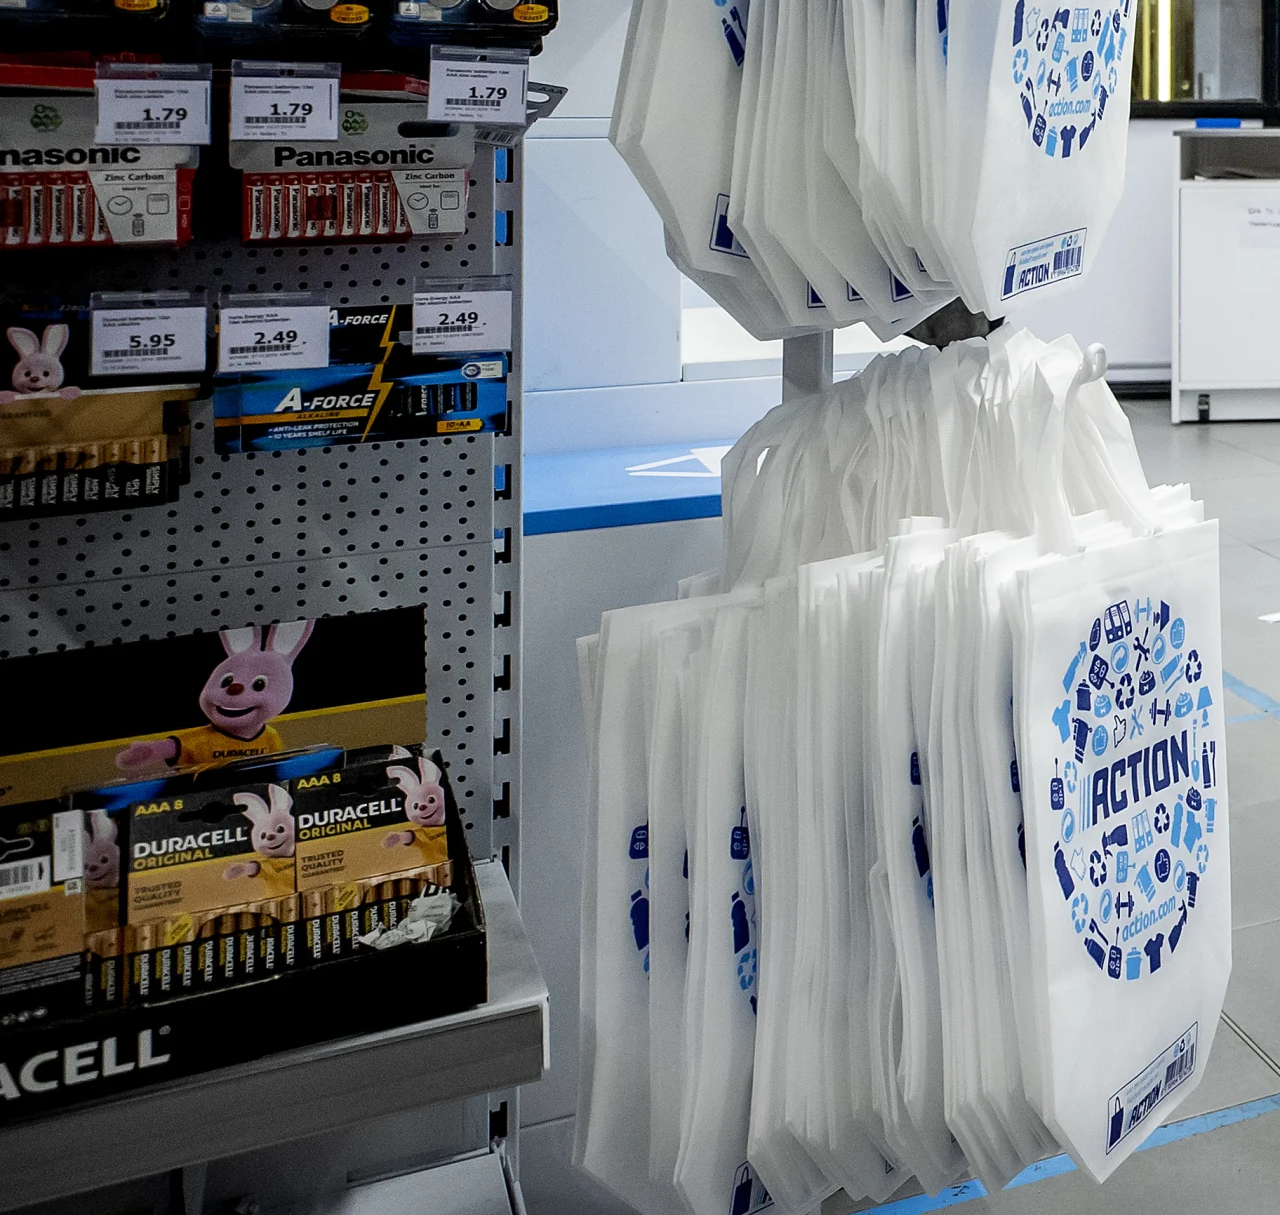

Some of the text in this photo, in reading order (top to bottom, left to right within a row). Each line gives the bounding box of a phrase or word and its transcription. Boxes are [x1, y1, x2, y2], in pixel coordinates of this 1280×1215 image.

[468, 87, 508, 100] 1.79
[142, 108, 188, 121] 1.79
[269, 102, 313, 117] 1.79
[1049, 98, 1092, 120] action.com
[0, 147, 141, 165] nasonic
[274, 144, 435, 167] Panasonic
[104, 172, 164, 182] Zinc Carbon
[254, 189, 263, 234] Panasonic
[1018, 262, 1050, 289] ACTION
[438, 312, 478, 325] 2.49
[129, 334, 176, 349] 5.95
[254, 330, 298, 344] 2.49
[275, 387, 375, 413] A-FORCE
[296, 411, 340, 419] ALKALINE
[284, 431, 308, 439] YEARS
[309, 429, 329, 437] SHELF
[315, 421, 359, 430] PROTECTION
[298, 773, 341, 789] AAA 8
[1092, 730, 1190, 825] ACTION
[299, 799, 402, 829] DURACELL
[300, 818, 371, 840] ORIGINAL
[133, 827, 248, 859] DURACELL
[302, 850, 345, 863] TRUSTED
[302, 857, 345, 873] QUALITY
[1121, 896, 1177, 940] action.com
[313, 918, 321, 958] DURACELL
[0, 1029, 171, 1100] ACELL
[1129, 1080, 1162, 1129] ACTION
